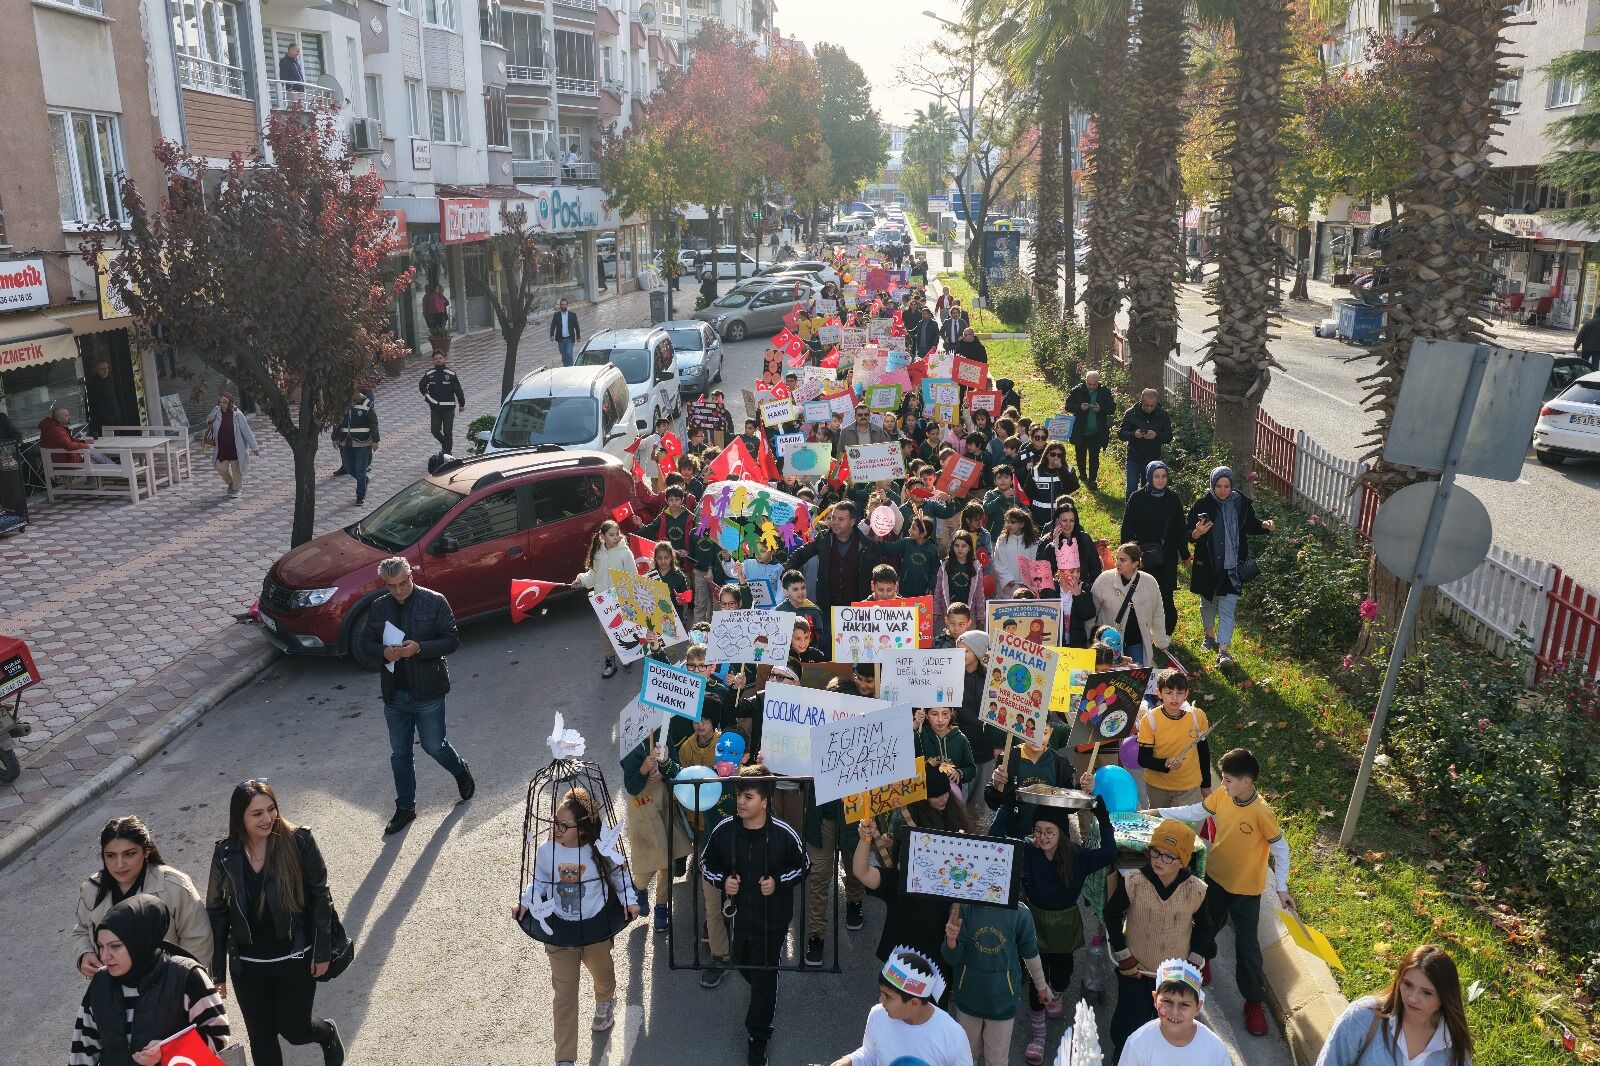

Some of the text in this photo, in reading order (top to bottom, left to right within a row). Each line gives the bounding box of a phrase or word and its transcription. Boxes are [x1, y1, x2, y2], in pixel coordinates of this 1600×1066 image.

[550, 190, 584, 229] Post
[0, 264, 43, 290] metik
[767, 408, 789, 420] HAKKI
[841, 608, 914, 622] OYUN OYNAMA
[842, 622, 909, 632] HAKKIM VAR
[1005, 634, 1046, 658] ÇOCUK
[1000, 645, 1047, 672] HAKLARI
[649, 665, 700, 689] DÜŞÜNCE VE
[651, 677, 695, 699] ÖZGÜRLÜK
[656, 692, 686, 710] HAKKI
[999, 688, 1033, 707] HER ÇOCUK
[766, 699, 826, 727] ÇOCUKLARA
[828, 721, 886, 754] EĞİTİM
[870, 797, 903, 815] VAR
